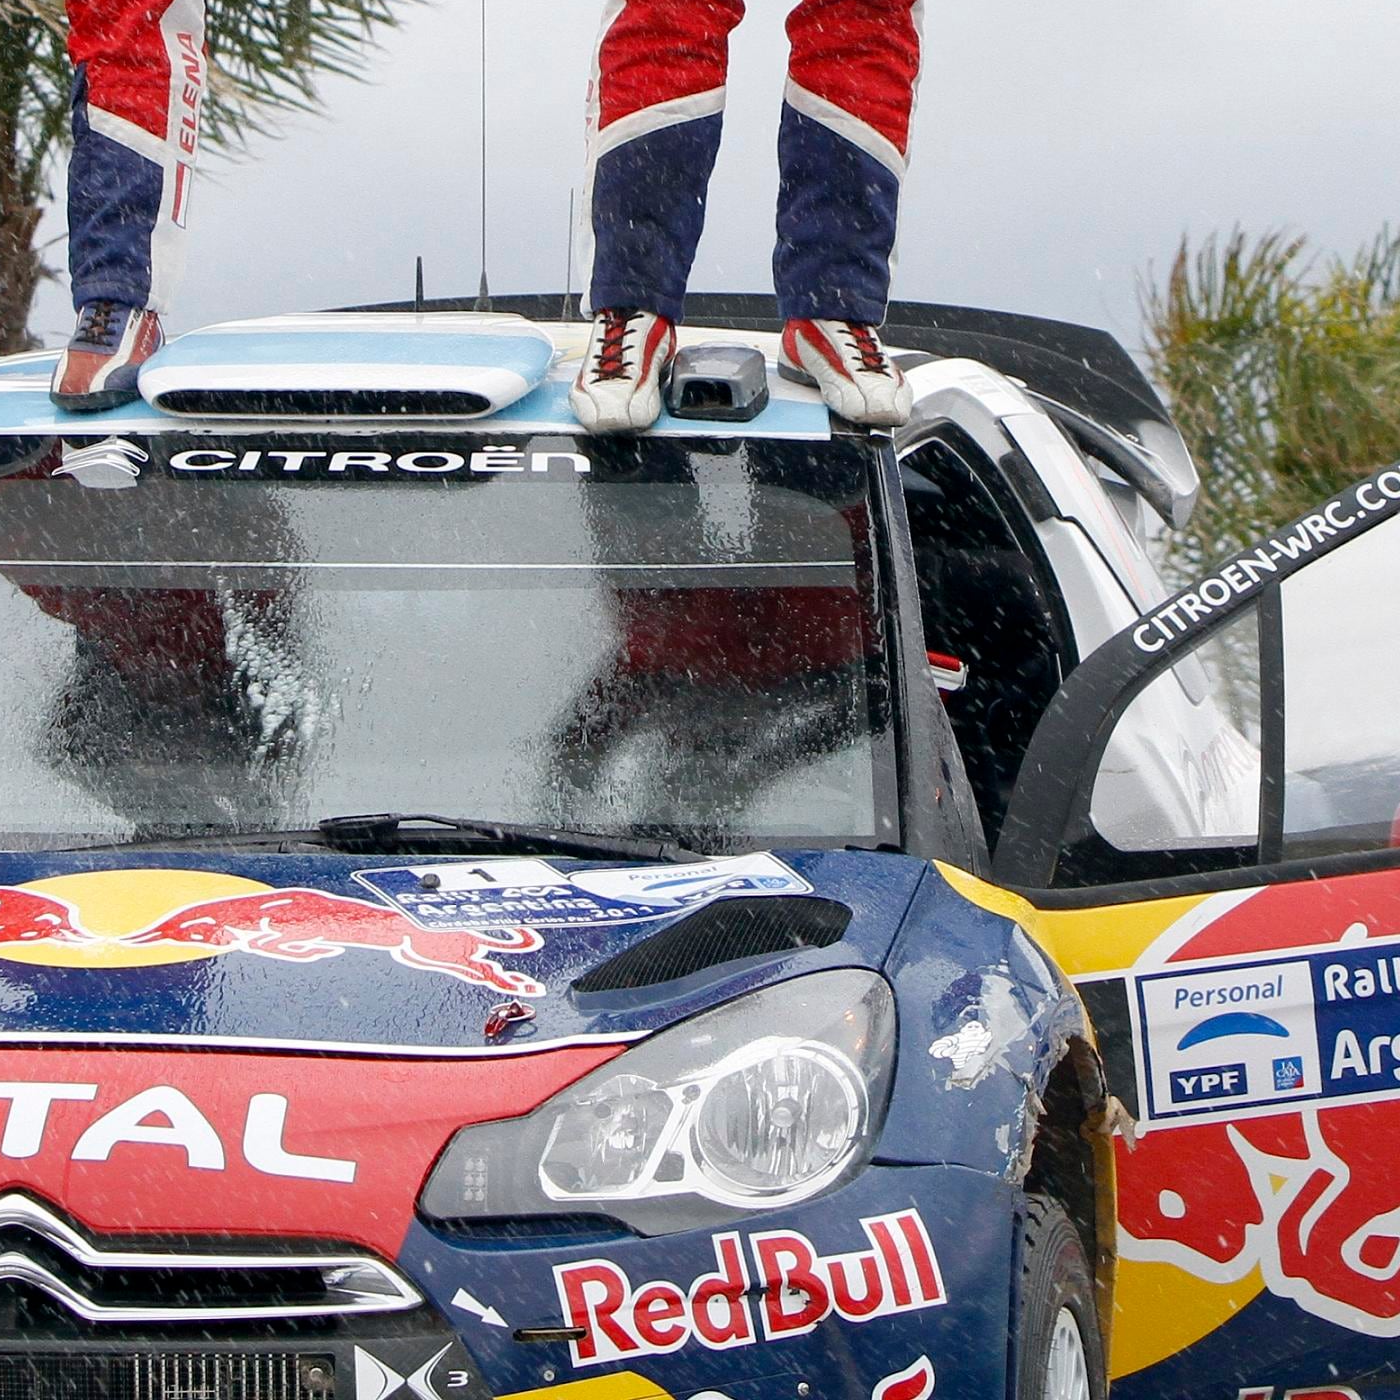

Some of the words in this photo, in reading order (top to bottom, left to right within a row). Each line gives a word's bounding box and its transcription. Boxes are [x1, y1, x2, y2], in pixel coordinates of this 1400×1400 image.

[178, 31, 204, 154] ELENA
[467, 868, 498, 882] 1
[627, 865, 719, 882] Personal
[415, 897, 601, 917] Argentina
[592, 904, 655, 919] 2011
[1173, 974, 1283, 1010] Personal
[1177, 1070, 1240, 1095] YPF
